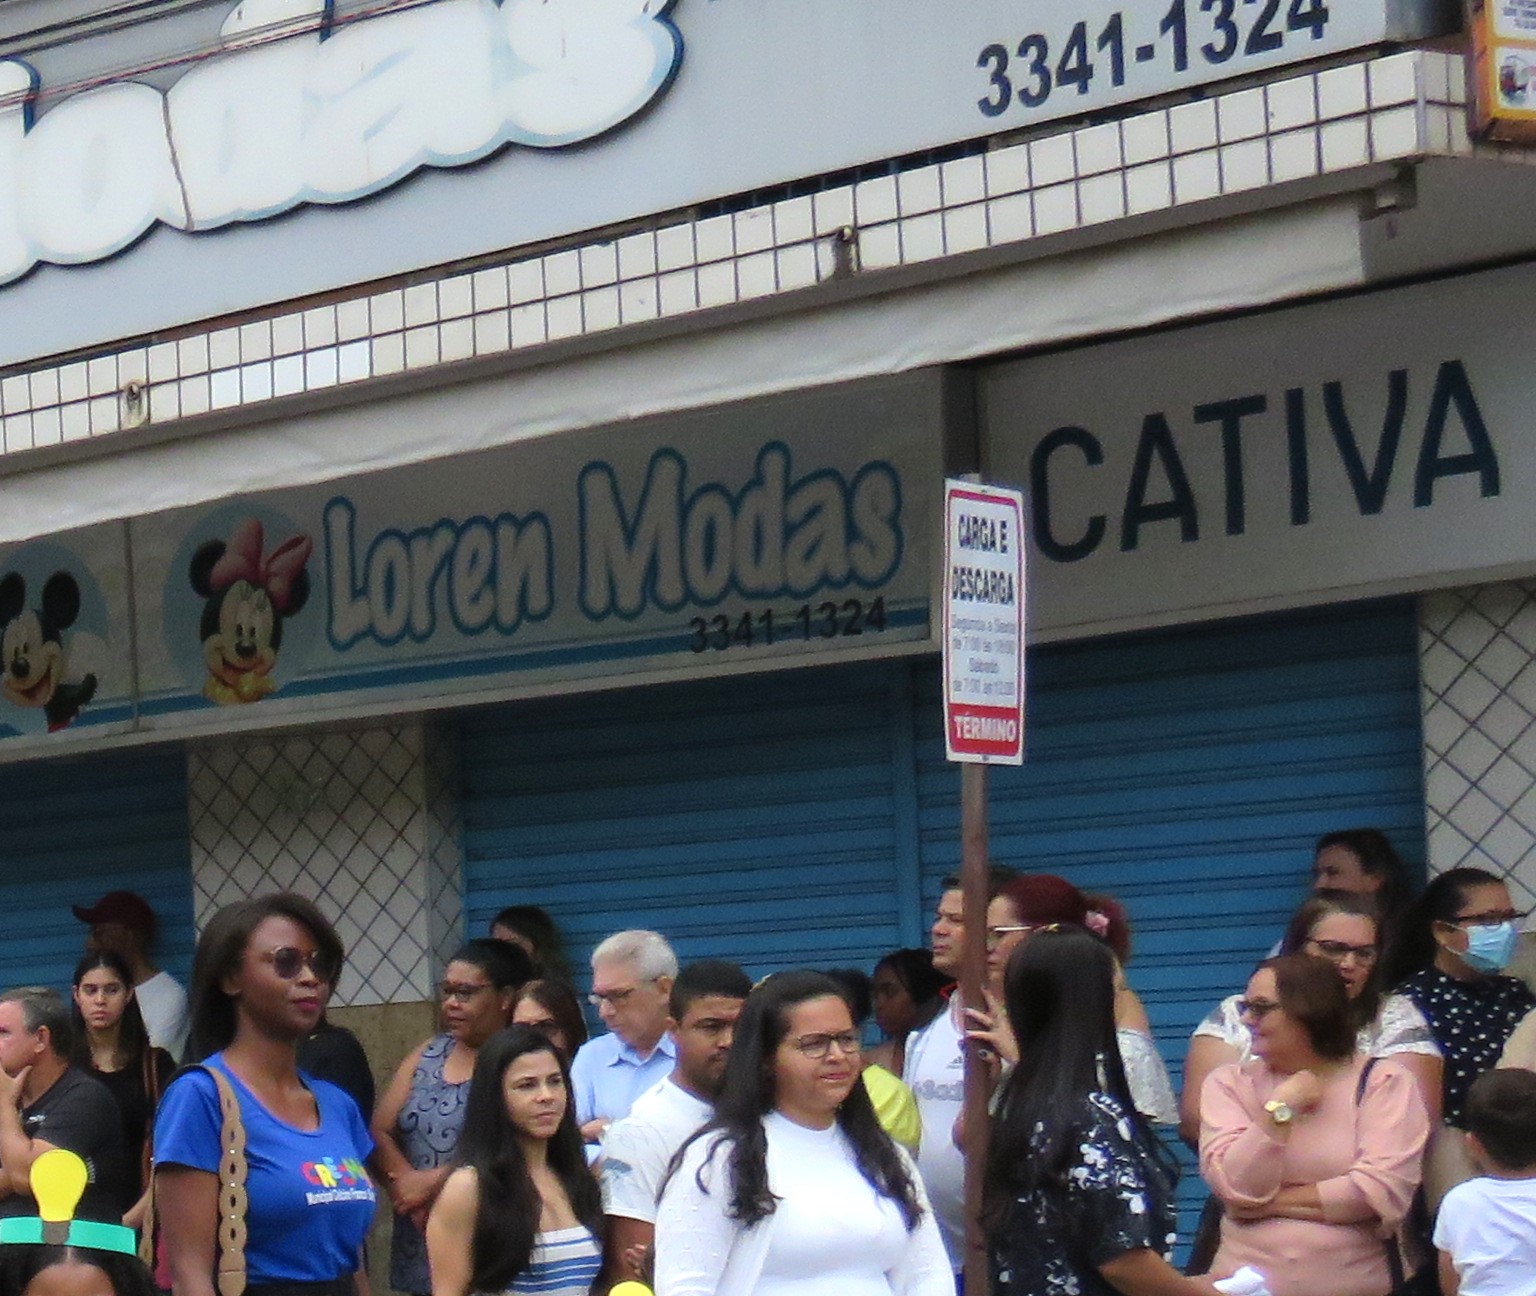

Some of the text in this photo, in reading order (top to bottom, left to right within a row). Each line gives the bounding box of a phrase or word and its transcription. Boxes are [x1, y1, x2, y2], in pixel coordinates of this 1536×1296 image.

[975, 0, 1330, 118] 3341-1324
[1028, 358, 1502, 564] CATIVA
[323, 439, 902, 652] Loren Modas
[958, 514, 1008, 553] CARGA E
[951, 565, 1016, 606] DESCARGA
[689, 598, 887, 654] 3341-1324
[954, 712, 1018, 743] TÉRMINO
